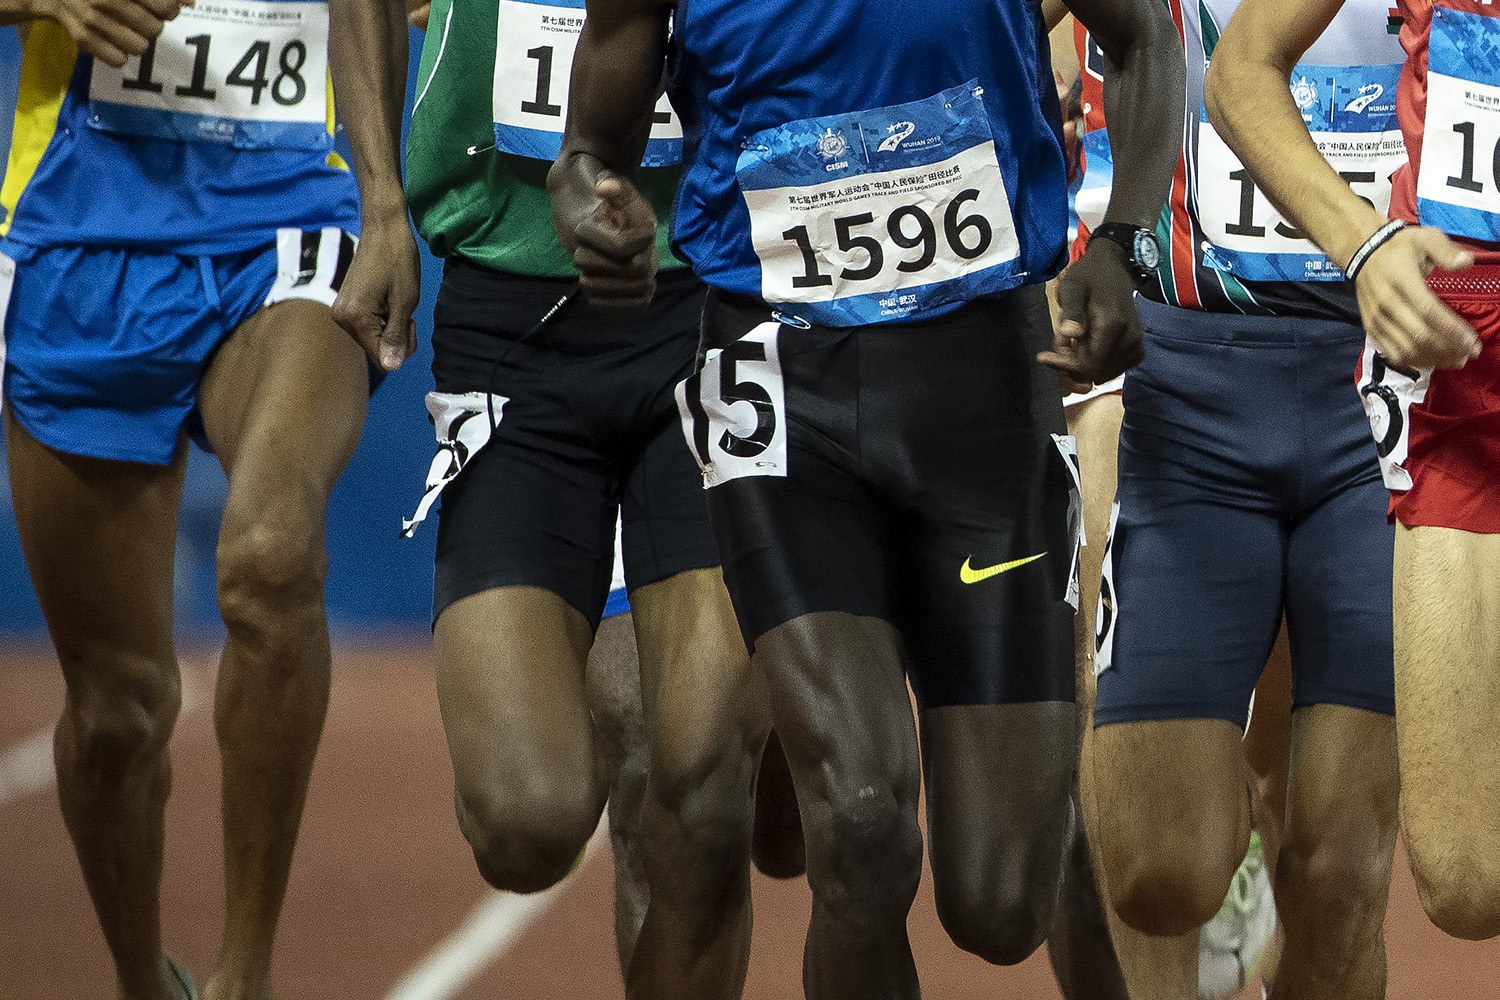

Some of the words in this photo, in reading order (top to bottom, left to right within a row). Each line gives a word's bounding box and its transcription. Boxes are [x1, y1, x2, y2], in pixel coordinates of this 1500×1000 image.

[541, 14, 583, 27] 第七届世界
[121, 33, 308, 107] 1148
[1368, 104, 1389, 112] WUHAN
[901, 139, 926, 149] WUHAN
[926, 135, 941, 145] 2019
[1315, 140, 1405, 151] 会“中国人民保险”田径比
[826, 160, 849, 172] CISM
[781, 188, 993, 289] 1596
